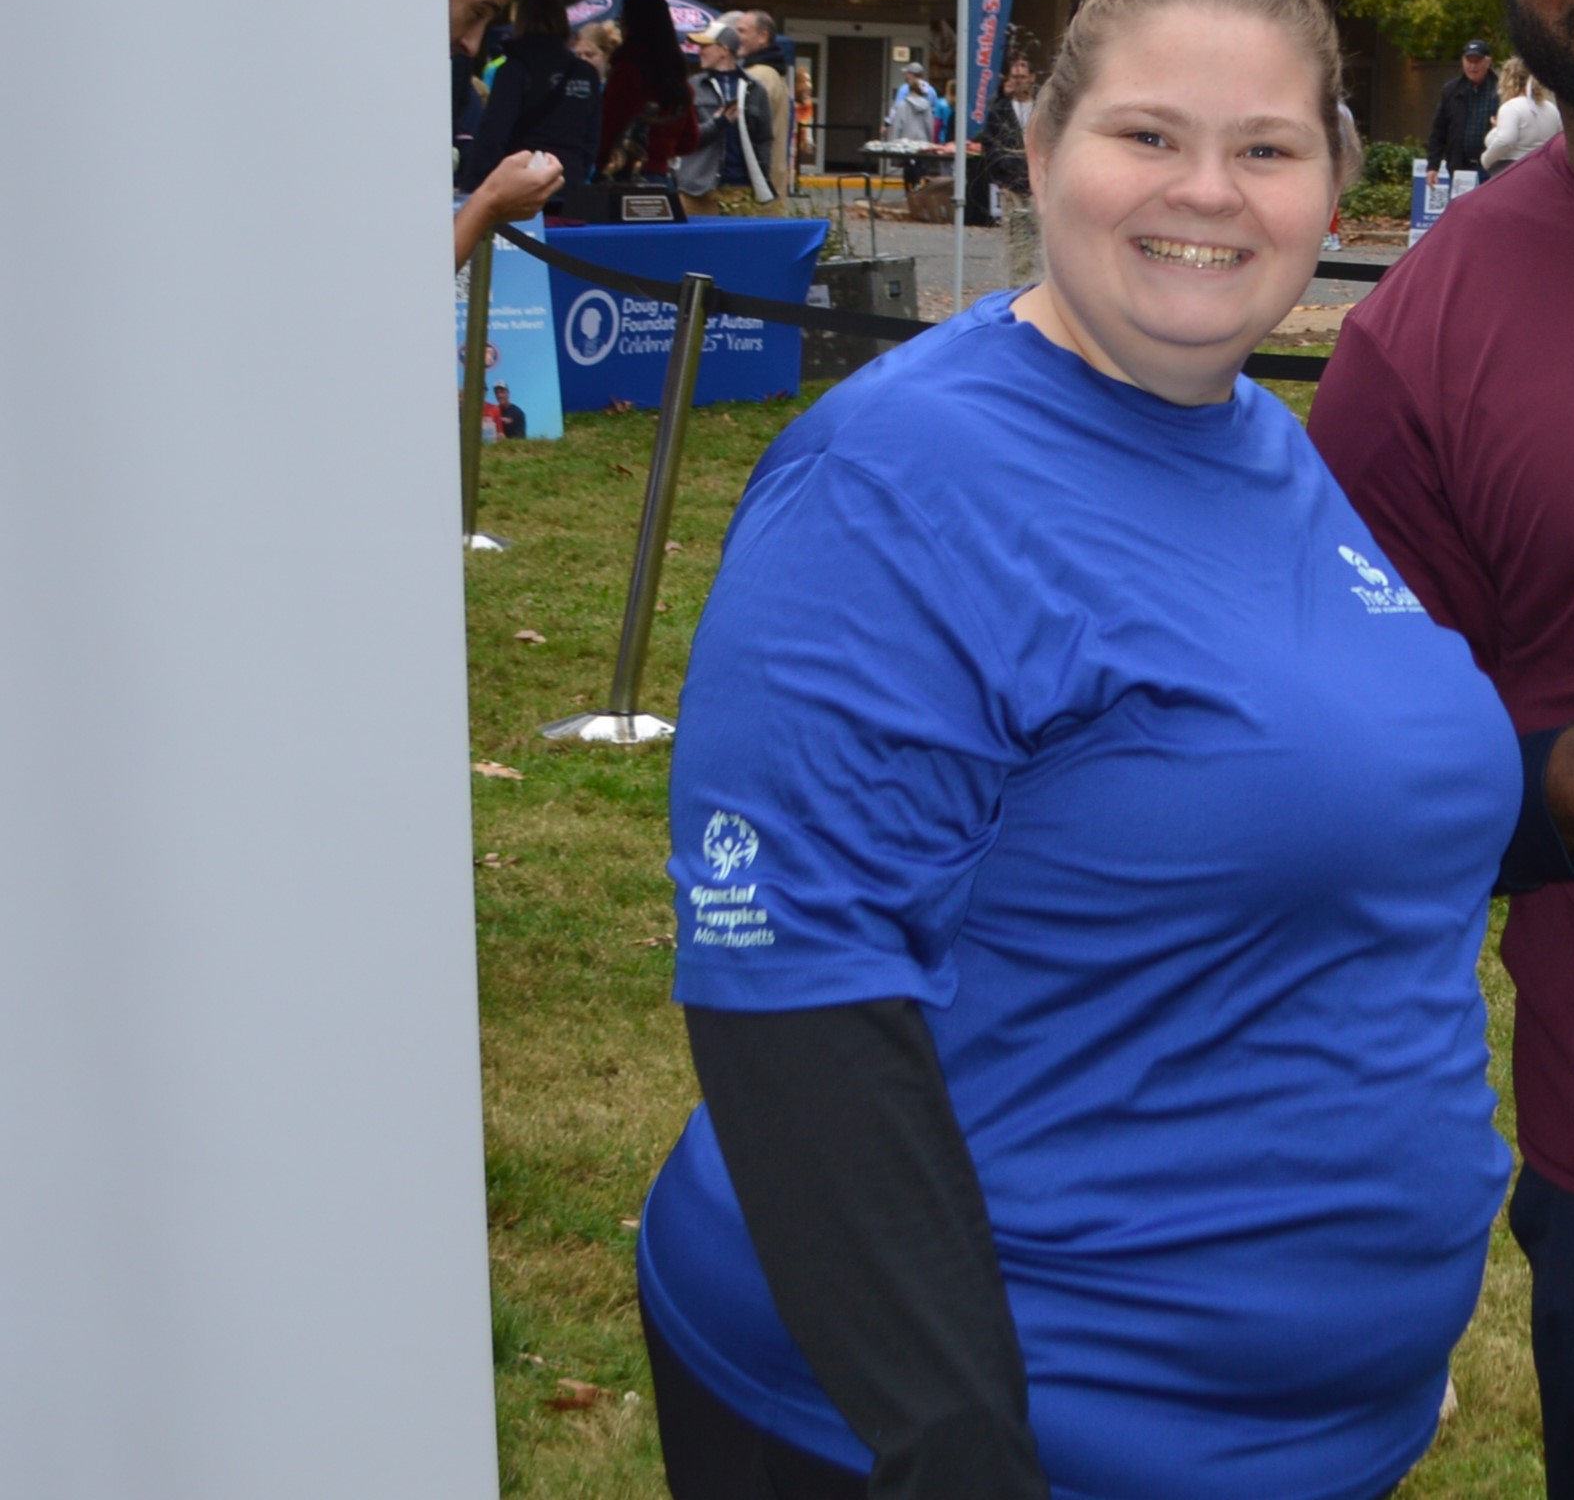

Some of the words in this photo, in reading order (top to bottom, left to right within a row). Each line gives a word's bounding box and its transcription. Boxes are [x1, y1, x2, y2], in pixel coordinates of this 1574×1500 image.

[488, 306, 523, 317] amilies
[621, 297, 659, 317] Doug
[621, 315, 677, 332] Foundat
[719, 313, 765, 330] Autism
[619, 335, 675, 355] Celebrat
[726, 333, 765, 352] Years
[689, 884, 757, 909] Special
